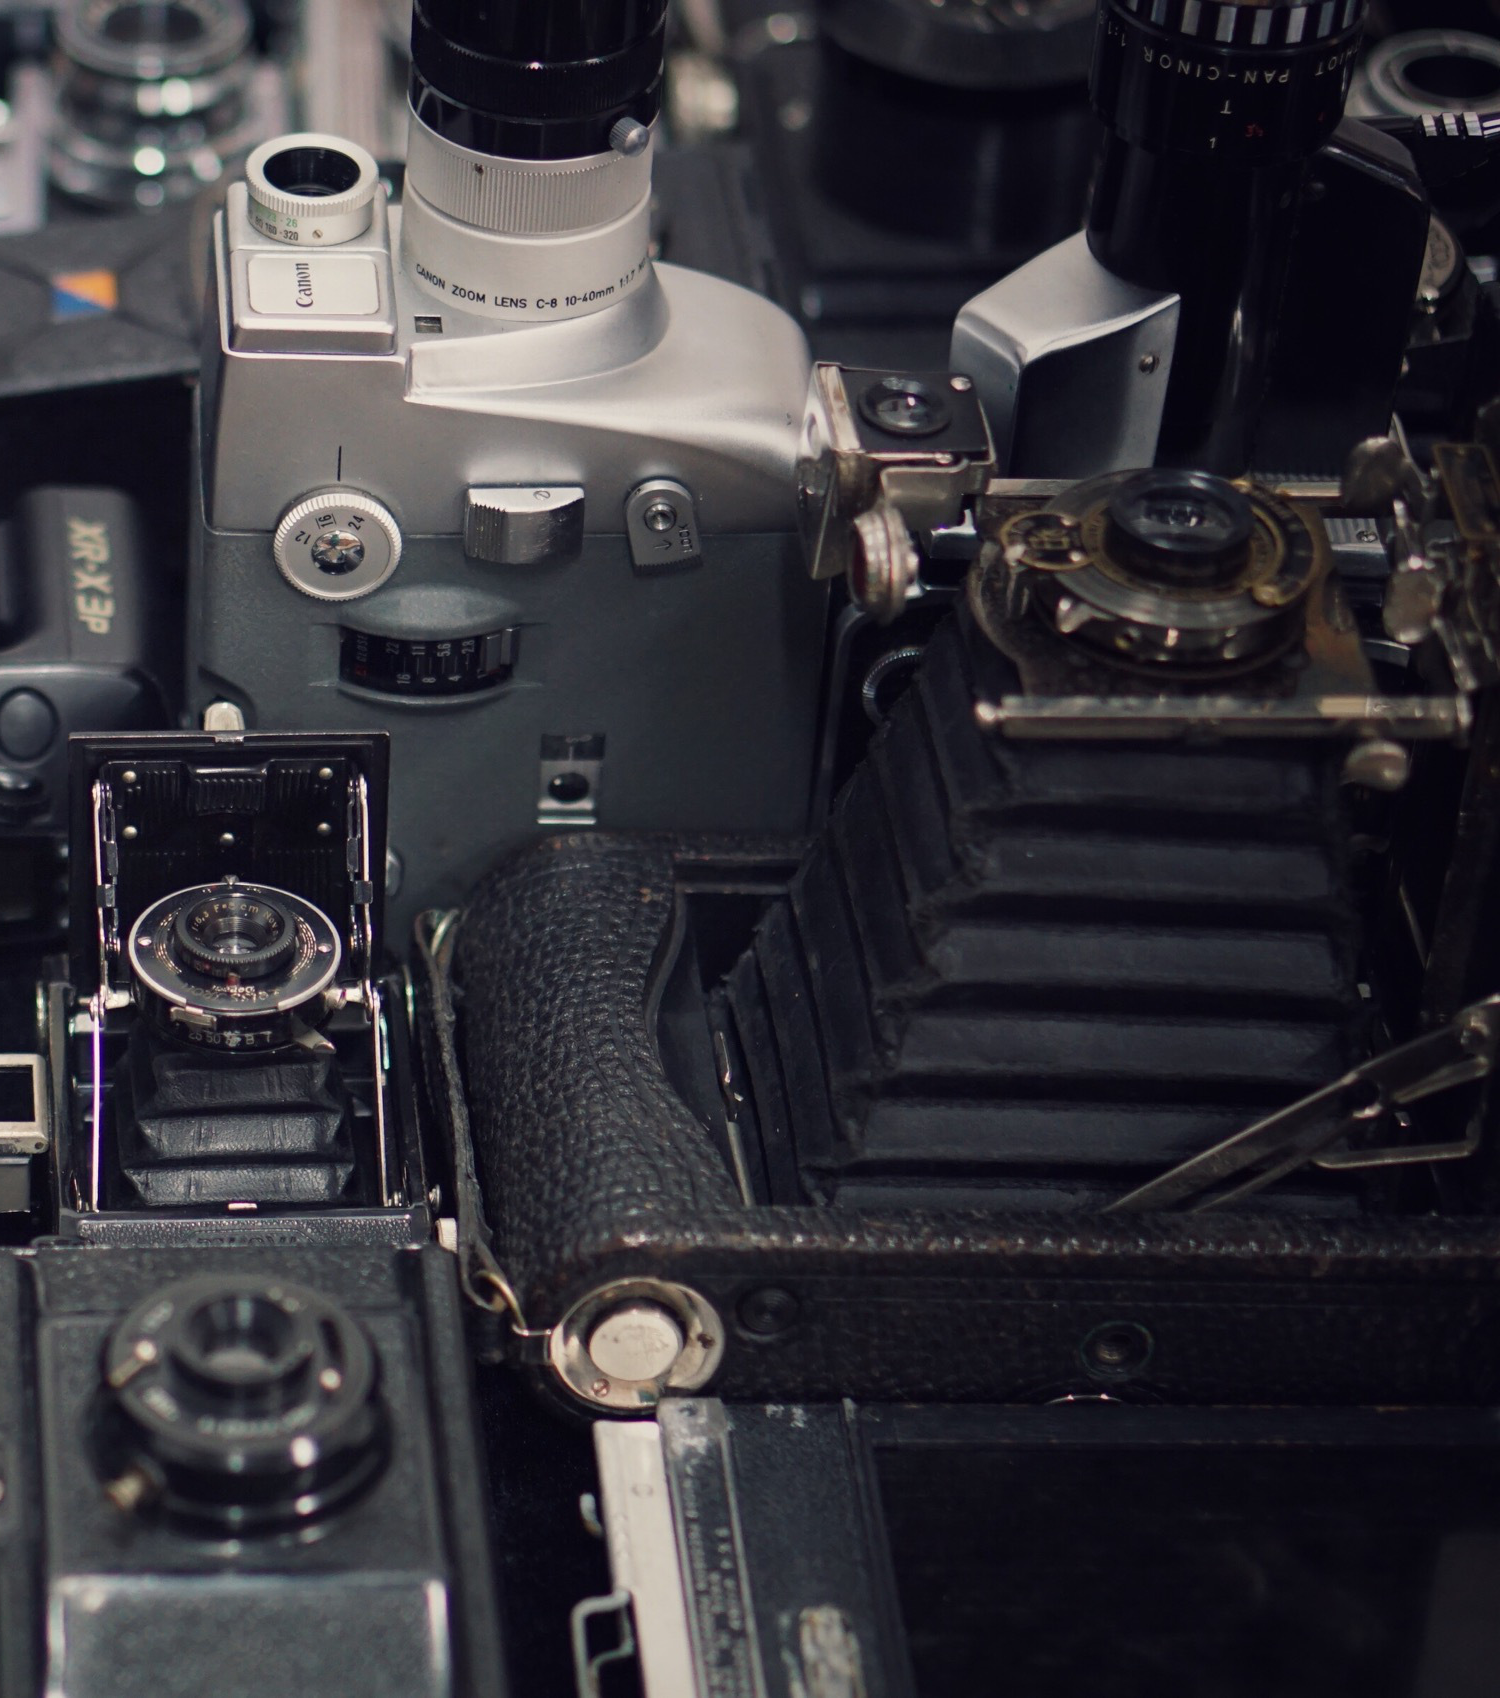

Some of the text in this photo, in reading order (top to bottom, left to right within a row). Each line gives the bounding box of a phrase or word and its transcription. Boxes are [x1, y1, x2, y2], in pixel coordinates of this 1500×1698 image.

[1143, 46, 1290, 84] PAN-CINOR
[286, 217, 298, 228] 26
[283, 230, 299, 241] 320
[295, 263, 314, 308] Canon
[415, 263, 446, 290] CANON
[451, 284, 486, 304] ZOOM
[494, 296, 528, 309] LENS
[536, 298, 558, 309] C-8
[564, 284, 615, 307] 10-40mm
[295, 514, 365, 545] 12 16 24
[678, 524, 693, 553] LOCK
[412, 645, 425, 656] 11
[437, 643, 452, 657] 5.6
[397, 673, 411, 684] 16
[448, 674, 462, 682] 4
[206, 1031, 220, 1044] 50
